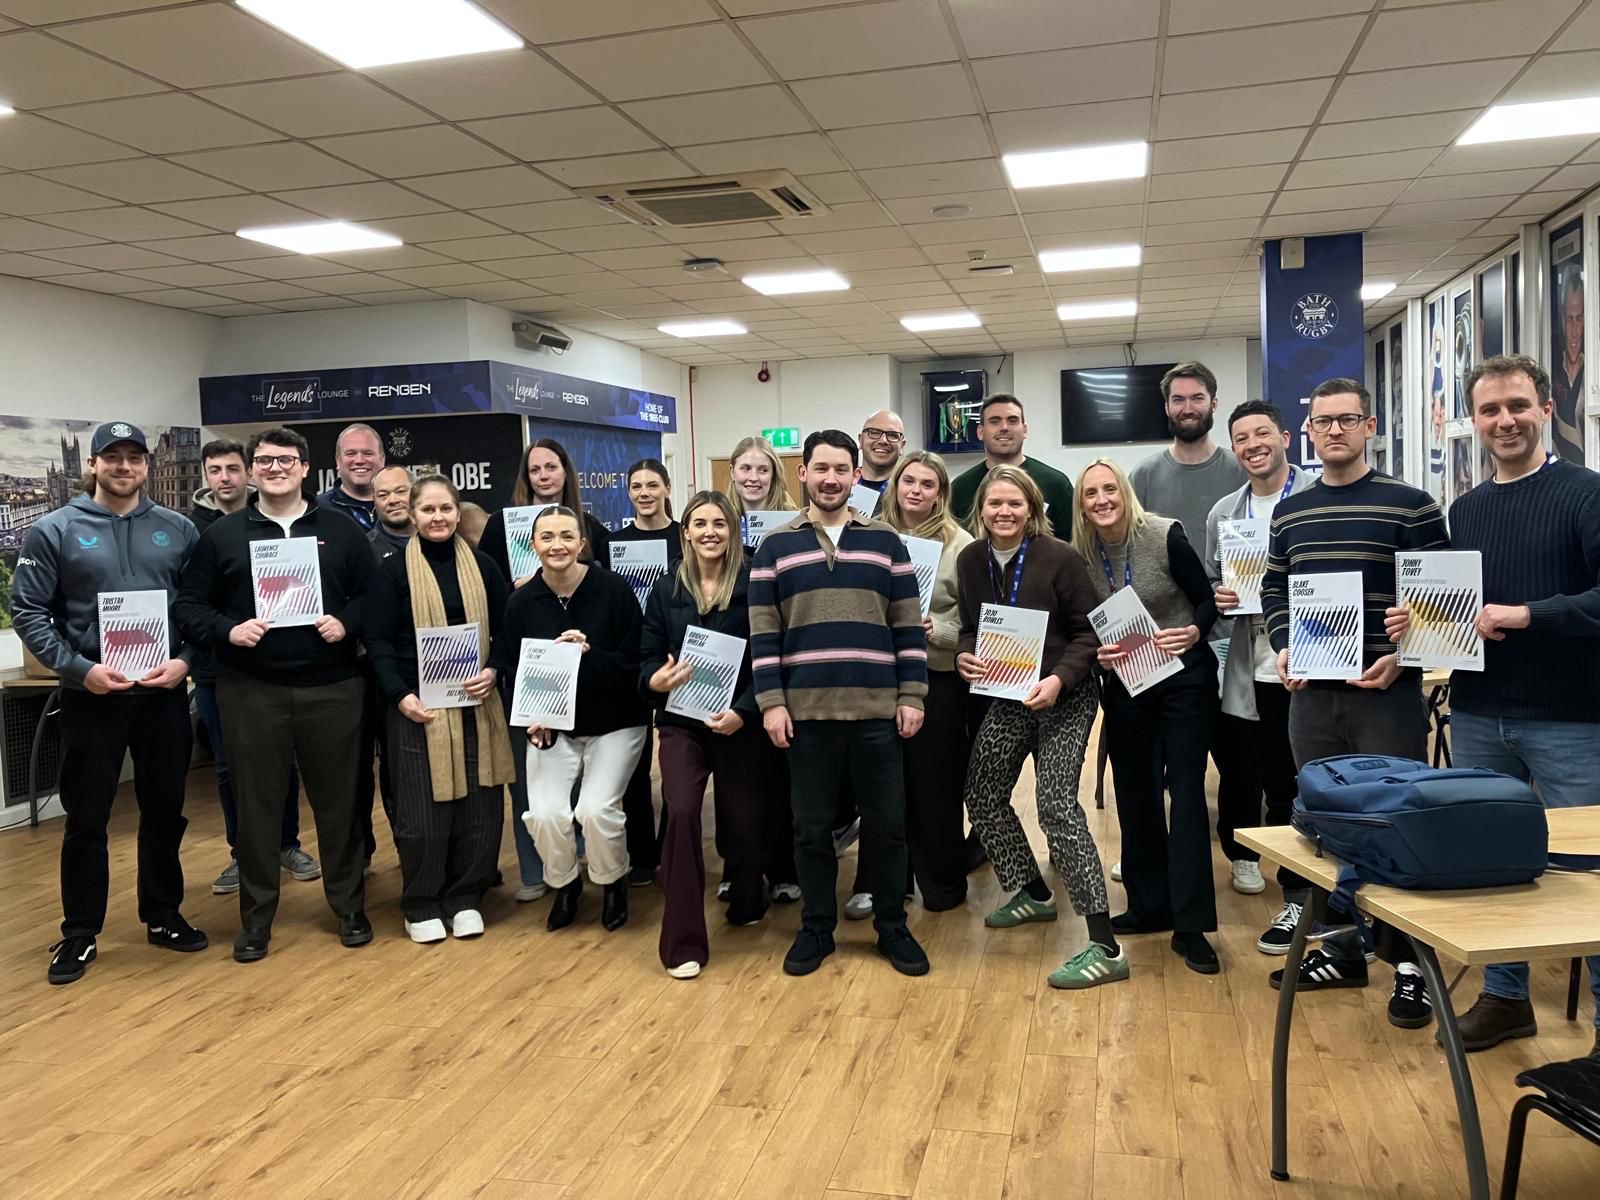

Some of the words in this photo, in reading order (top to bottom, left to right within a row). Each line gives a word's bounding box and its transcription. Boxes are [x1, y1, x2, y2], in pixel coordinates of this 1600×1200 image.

[1297, 294, 1331, 309] BATH
[1296, 320, 1333, 337] RUGBY
[252, 394, 266, 402] THE
[317, 389, 349, 399] LOUNGE
[368, 383, 431, 397] RENGEN
[562, 392, 589, 406] RENGEN
[645, 403, 657, 413] HOME
[640, 411, 649, 421] THE
[659, 414, 670, 424] CLUB
[1401, 559, 1422, 568] JONNY
[1402, 568, 1422, 576] TOVEY
[1292, 580, 1309, 588] BLAKE
[1292, 588, 1315, 596] COOSEN
[102, 597, 124, 605] TRISTAN
[983, 608, 998, 616] JOJO
[982, 616, 1004, 625] BOWLES
[688, 631, 709, 641] BRIDGET
